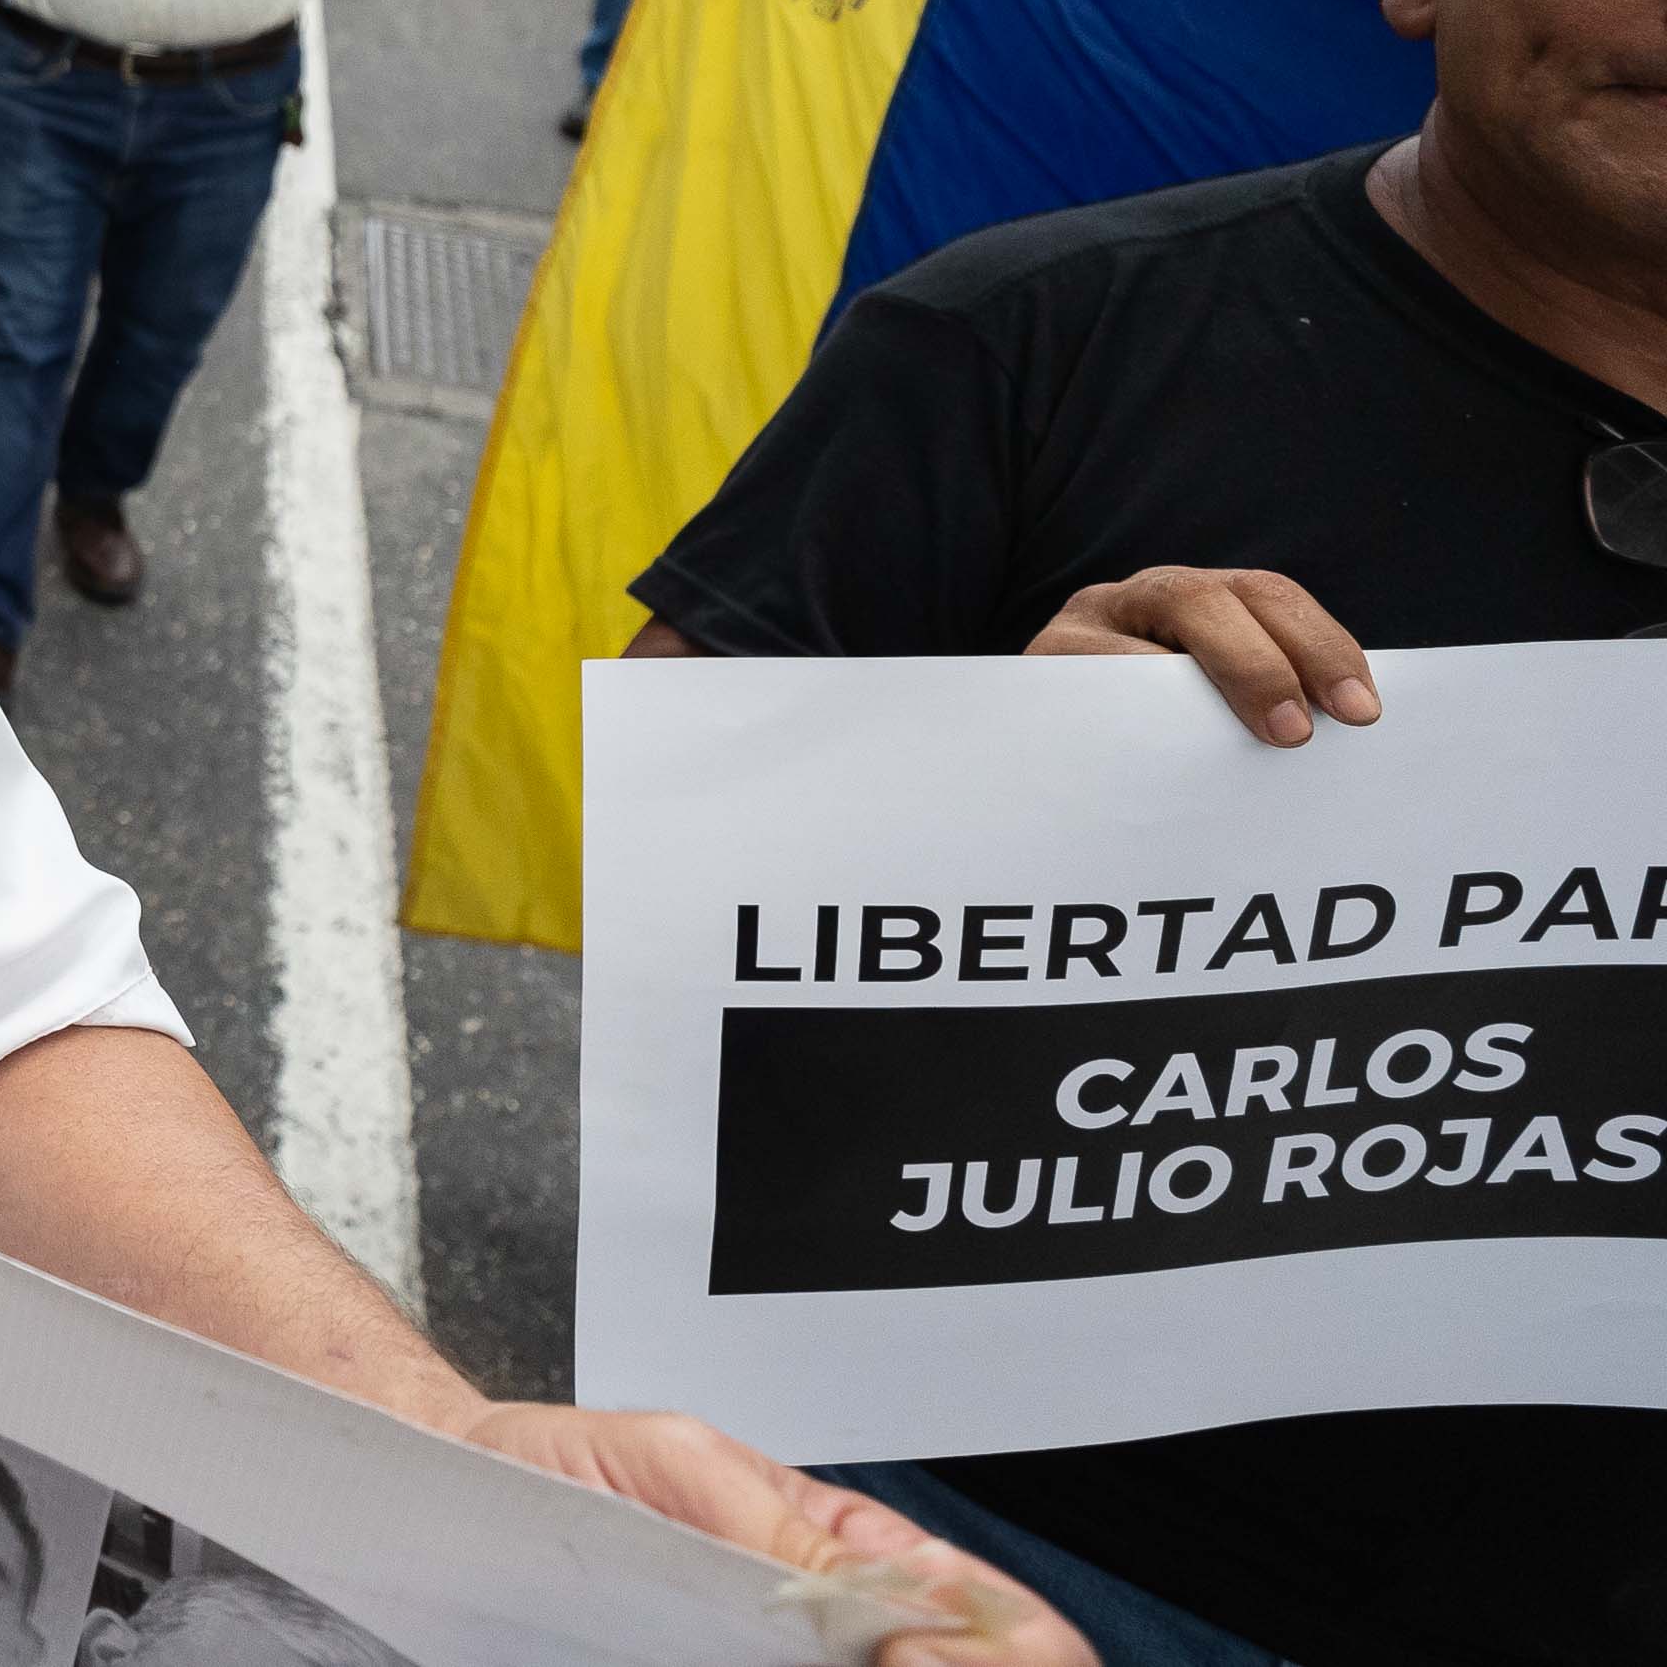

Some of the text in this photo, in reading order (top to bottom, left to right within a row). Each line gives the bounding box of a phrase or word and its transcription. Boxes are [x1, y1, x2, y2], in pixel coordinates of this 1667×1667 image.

[733, 882, 1399, 984] LIBERTAD
[1053, 1021, 1536, 1131] CARLOS
[888, 1112, 1667, 1233] JULIO ROJAS
